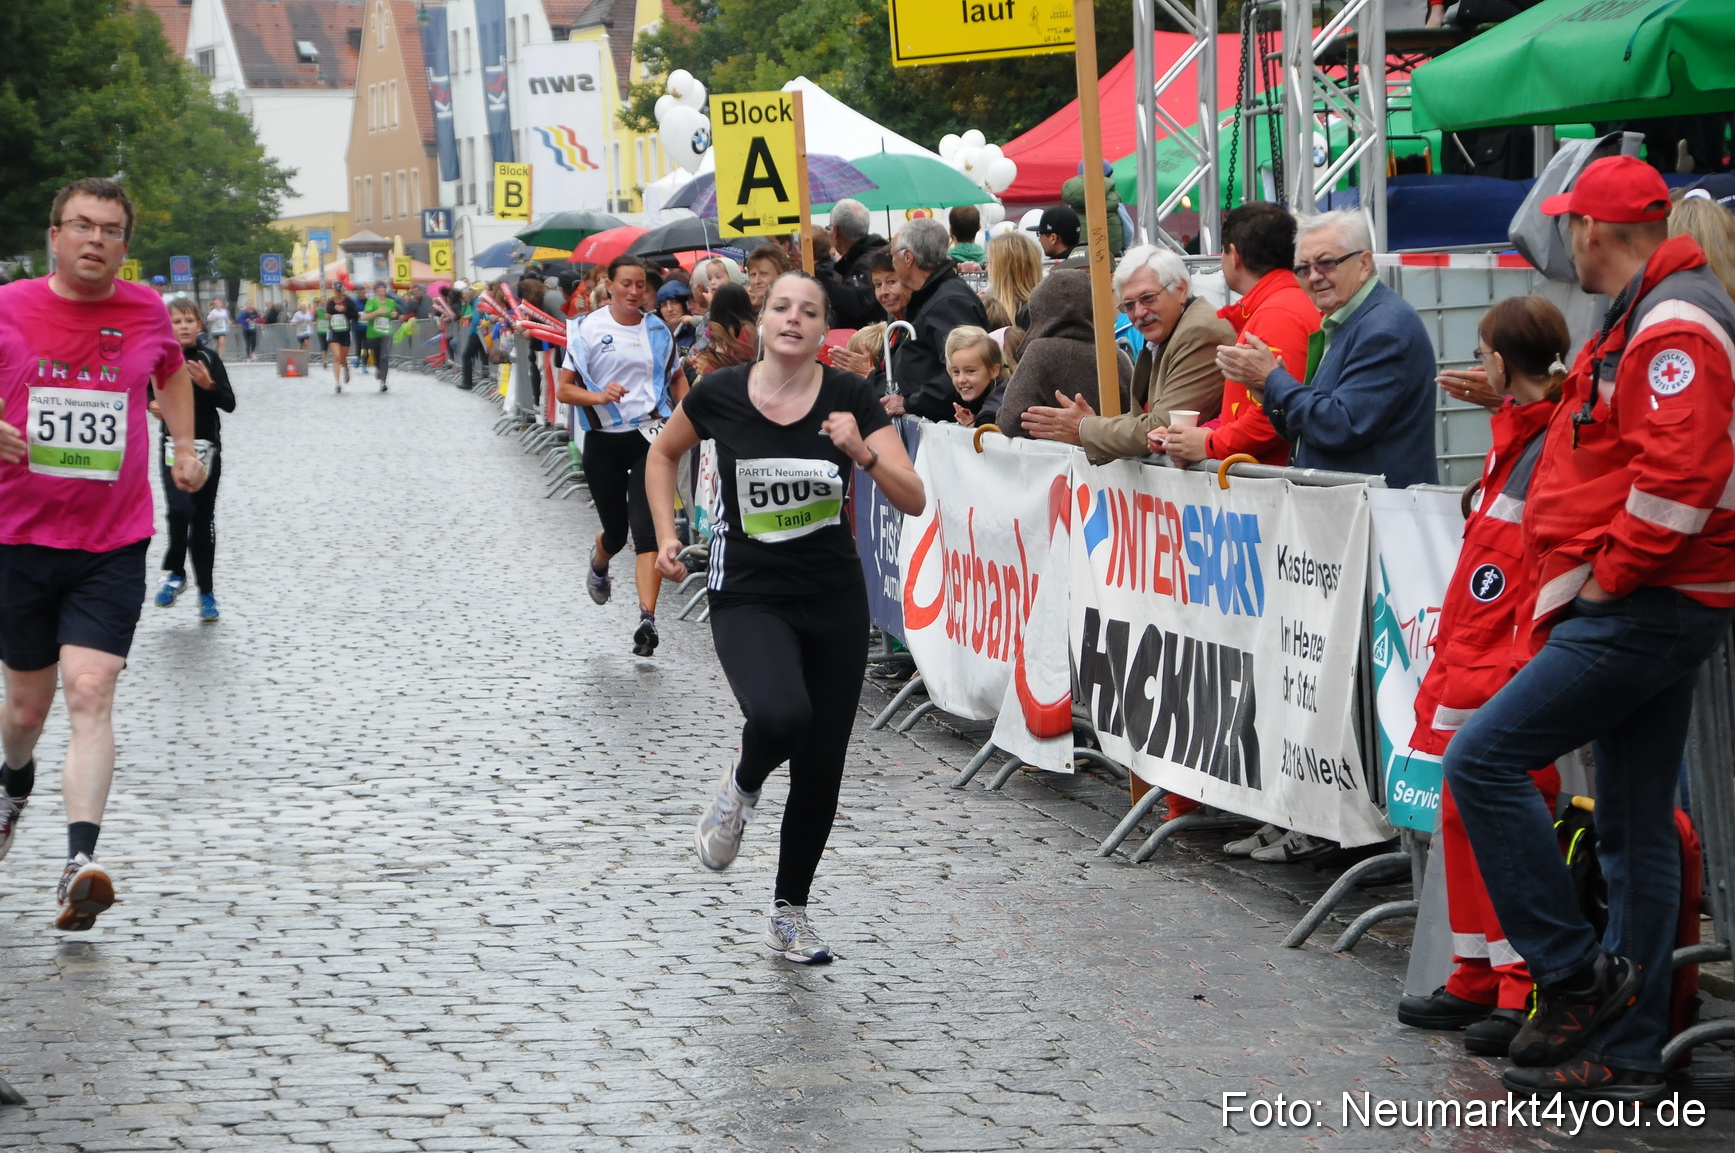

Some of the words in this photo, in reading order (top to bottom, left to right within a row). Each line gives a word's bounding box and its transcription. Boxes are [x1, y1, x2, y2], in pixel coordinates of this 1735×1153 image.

[963, 0, 1015, 23] lauf
[721, 97, 793, 125] Block
[499, 165, 529, 176] Block
[737, 136, 789, 205] A
[504, 181, 523, 208] B
[435, 250, 447, 266] C
[123, 268, 133, 281] D
[397, 264, 407, 277] D
[1653, 353, 1688, 371] DEUTSCHES
[37, 359, 121, 388] IRAN
[31, 396, 62, 406] PARTL
[64, 398, 110, 409] Neumarkt
[37, 410, 116, 446] 5133
[59, 452, 91, 466] John
[738, 468, 773, 477] PARTL
[775, 468, 823, 477] Neumarkt
[749, 480, 832, 508] 5003
[775, 511, 812, 528] Tanja
[1106, 487, 1265, 618] INTERSPORT
